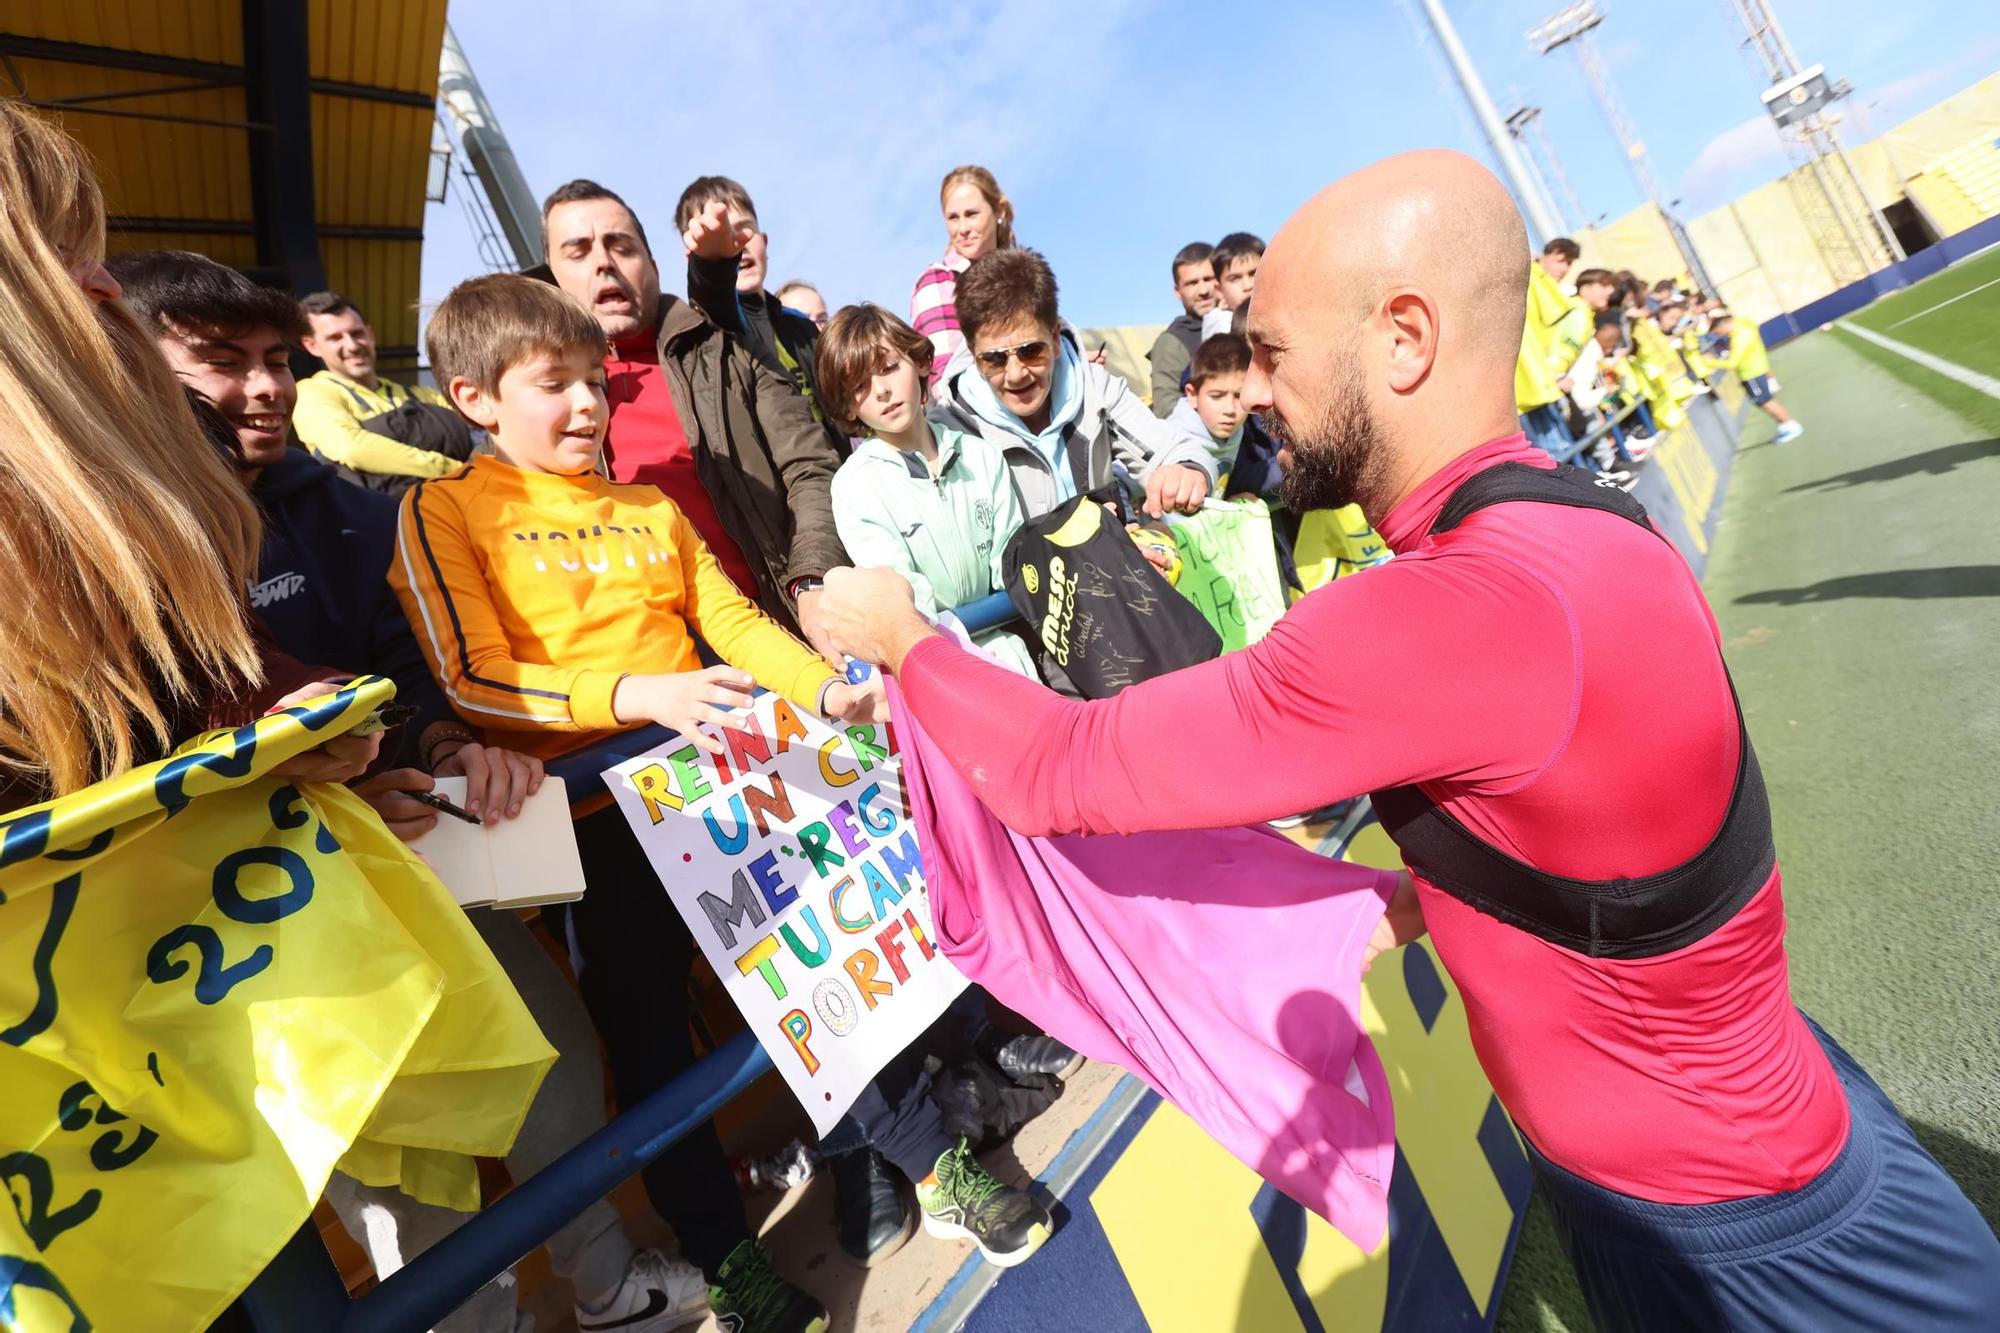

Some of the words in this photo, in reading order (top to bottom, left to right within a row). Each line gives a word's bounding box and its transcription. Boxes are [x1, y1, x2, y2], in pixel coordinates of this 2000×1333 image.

[1041, 555, 1066, 655] MESA
[630, 698, 809, 826] REINA
[703, 770, 797, 856] UN
[697, 849, 801, 950] ME
[735, 905, 832, 1001] TU
[778, 908, 936, 1078] PORFI
